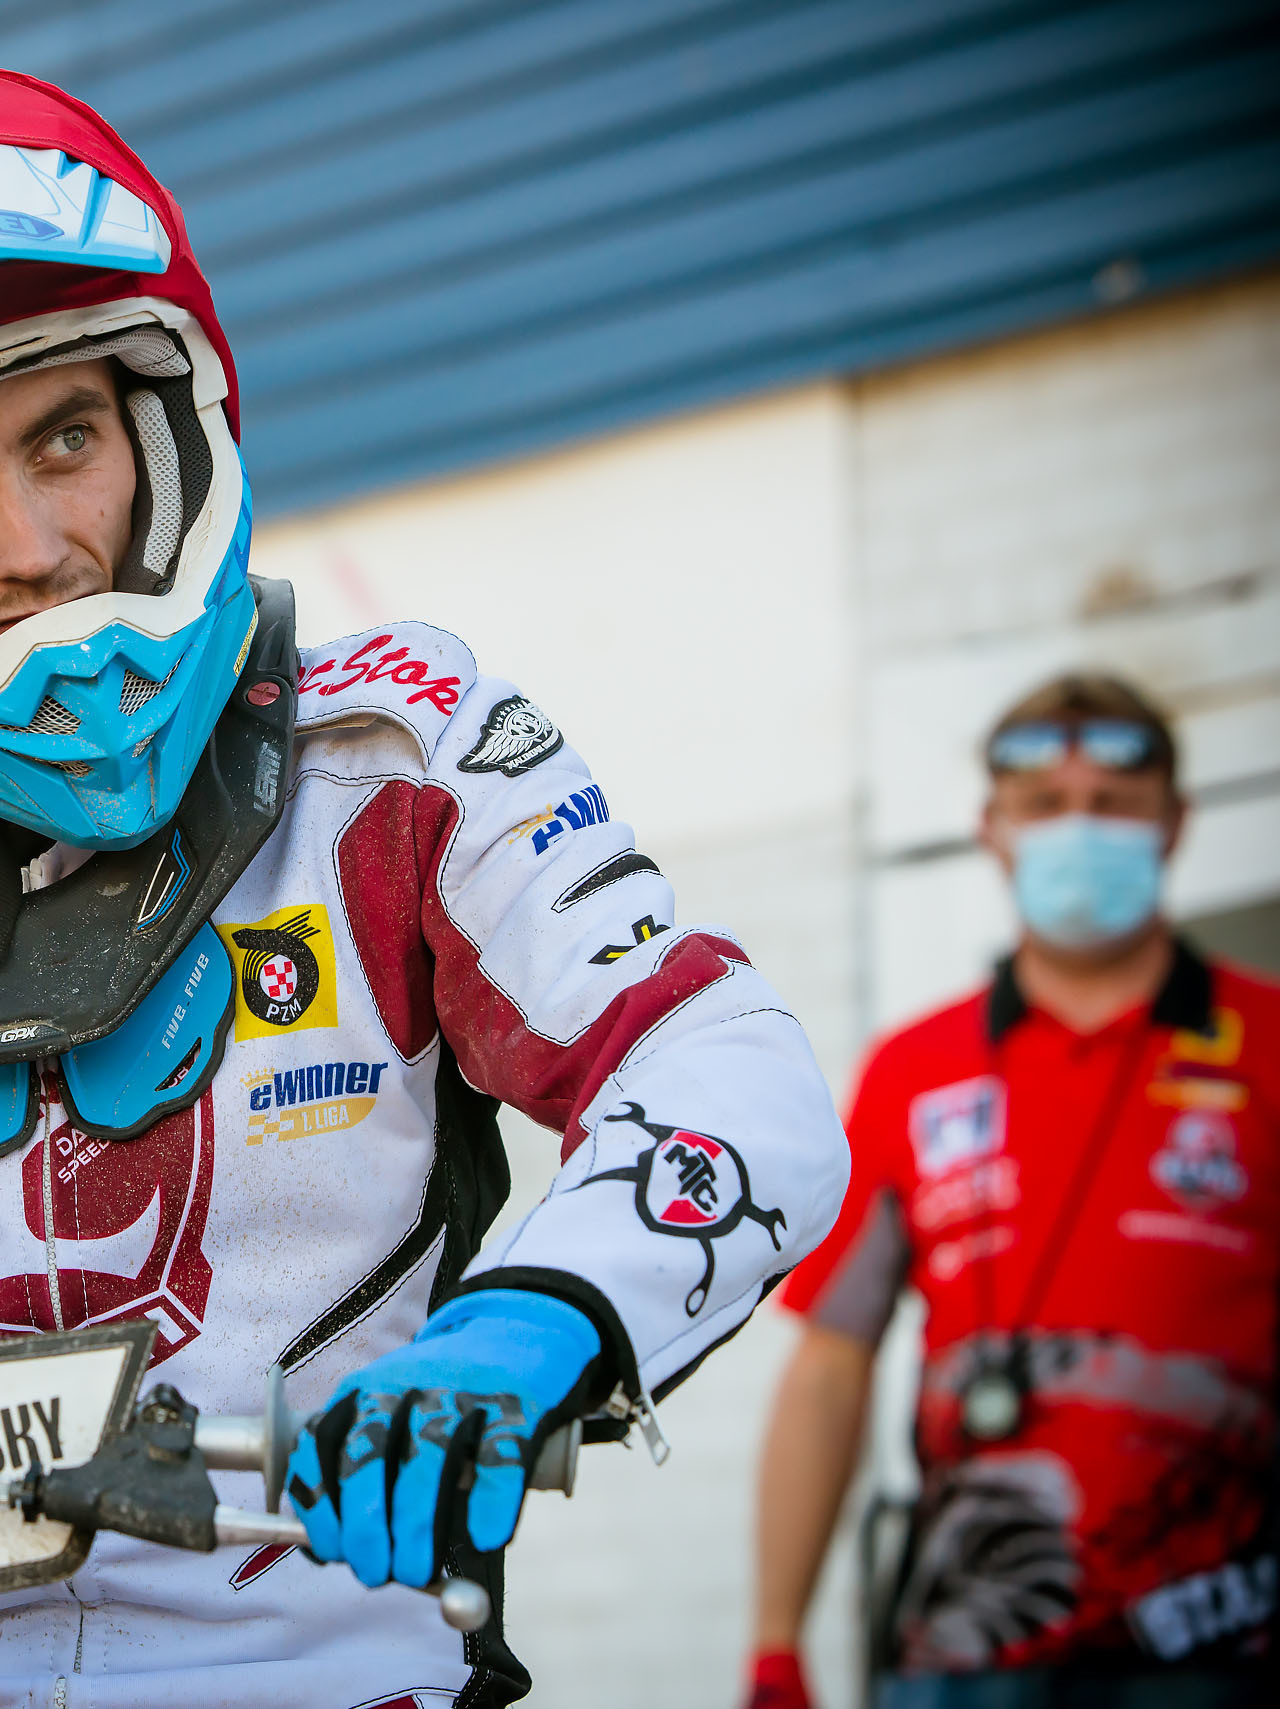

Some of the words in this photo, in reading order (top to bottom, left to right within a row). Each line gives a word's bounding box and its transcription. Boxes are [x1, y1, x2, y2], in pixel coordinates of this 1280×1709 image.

[161, 1003, 186, 1050] FIVE
[184, 952, 211, 998] FIVE
[265, 999, 303, 1022] PZM
[0, 1025, 40, 1044] GPX
[316, 1103, 350, 1130] LIGA
[663, 1143, 719, 1213] MTC
